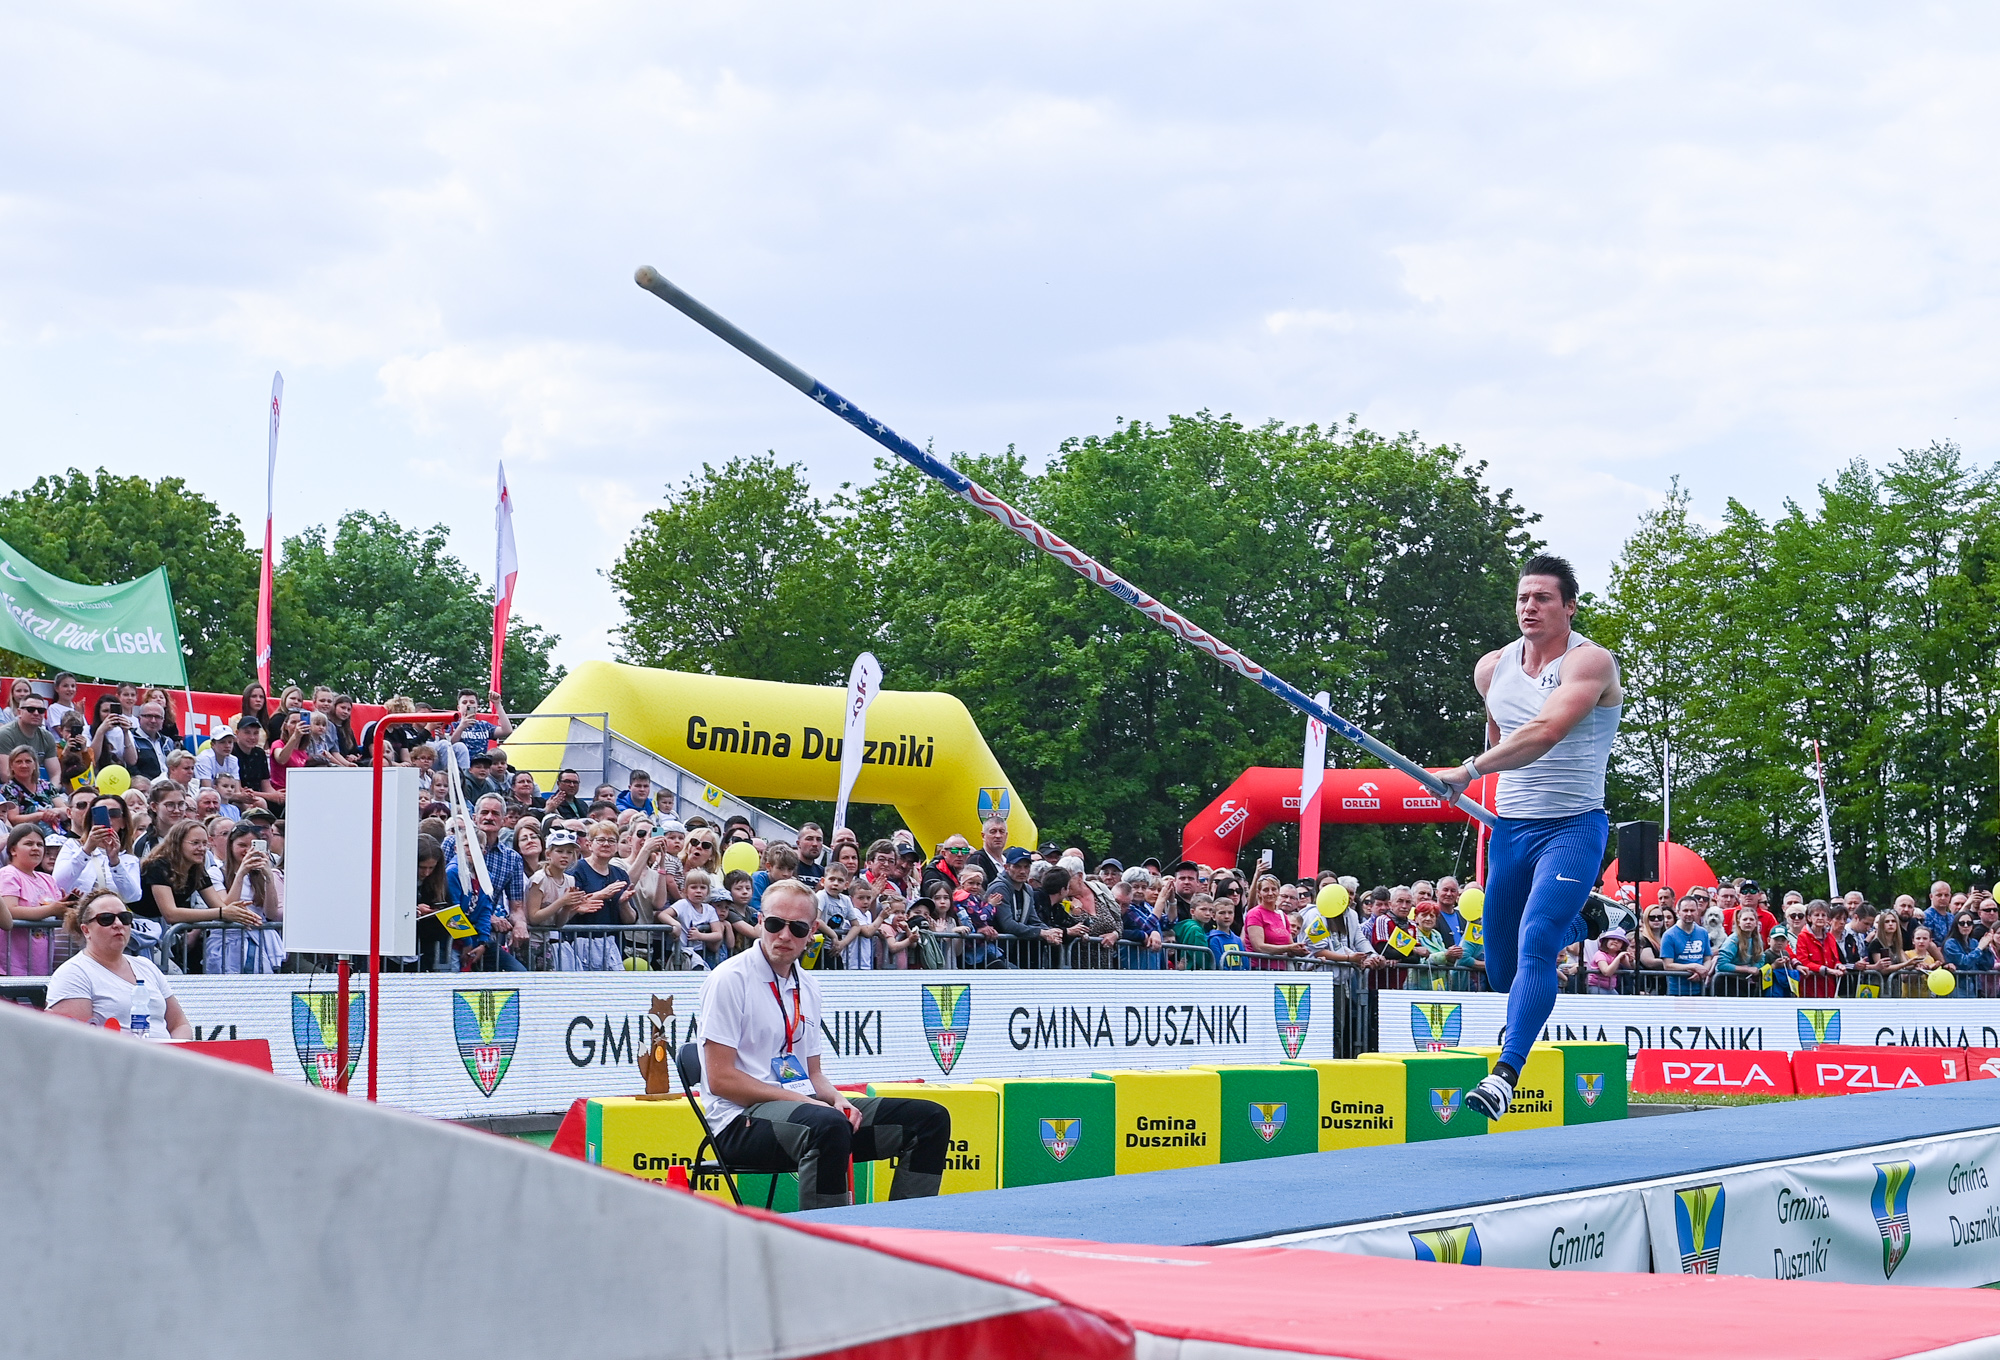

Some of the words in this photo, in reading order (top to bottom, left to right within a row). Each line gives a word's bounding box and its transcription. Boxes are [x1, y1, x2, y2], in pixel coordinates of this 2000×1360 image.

[53, 622, 101, 652] Piotr
[101, 626, 167, 655] Lisek
[686, 715, 791, 758] Gmina
[801, 726, 934, 768] Duzniki
[1344, 800, 1378, 808] ORLEN
[1405, 799, 1439, 807] ORLEN
[1218, 810, 1246, 835] ORLEN
[820, 1010, 882, 1056] NIKI
[1008, 1005, 1114, 1050] GMINA
[1125, 1004, 1247, 1047] DUSZNIKI
[1625, 1026, 1764, 1060] DUSZNIKI
[1662, 1062, 1775, 1087] PZLA
[1816, 1064, 1926, 1089] PZLA
[1331, 1100, 1384, 1115] Gmina
[1504, 1101, 1552, 1113] szniki
[1136, 1116, 1197, 1132] Gmina
[1321, 1116, 1393, 1130] Duszniki
[1125, 1131, 1207, 1148] Duszniki
[633, 1152, 706, 1171] Gmin
[889, 1155, 980, 1170] Dniki
[1947, 1160, 1990, 1195] Gmina
[1777, 1187, 1830, 1225] Gmina
[1948, 1205, 2000, 1248] Duszniki
[1549, 1222, 1605, 1269] Gmina
[1774, 1237, 1831, 1281] Duszniki
